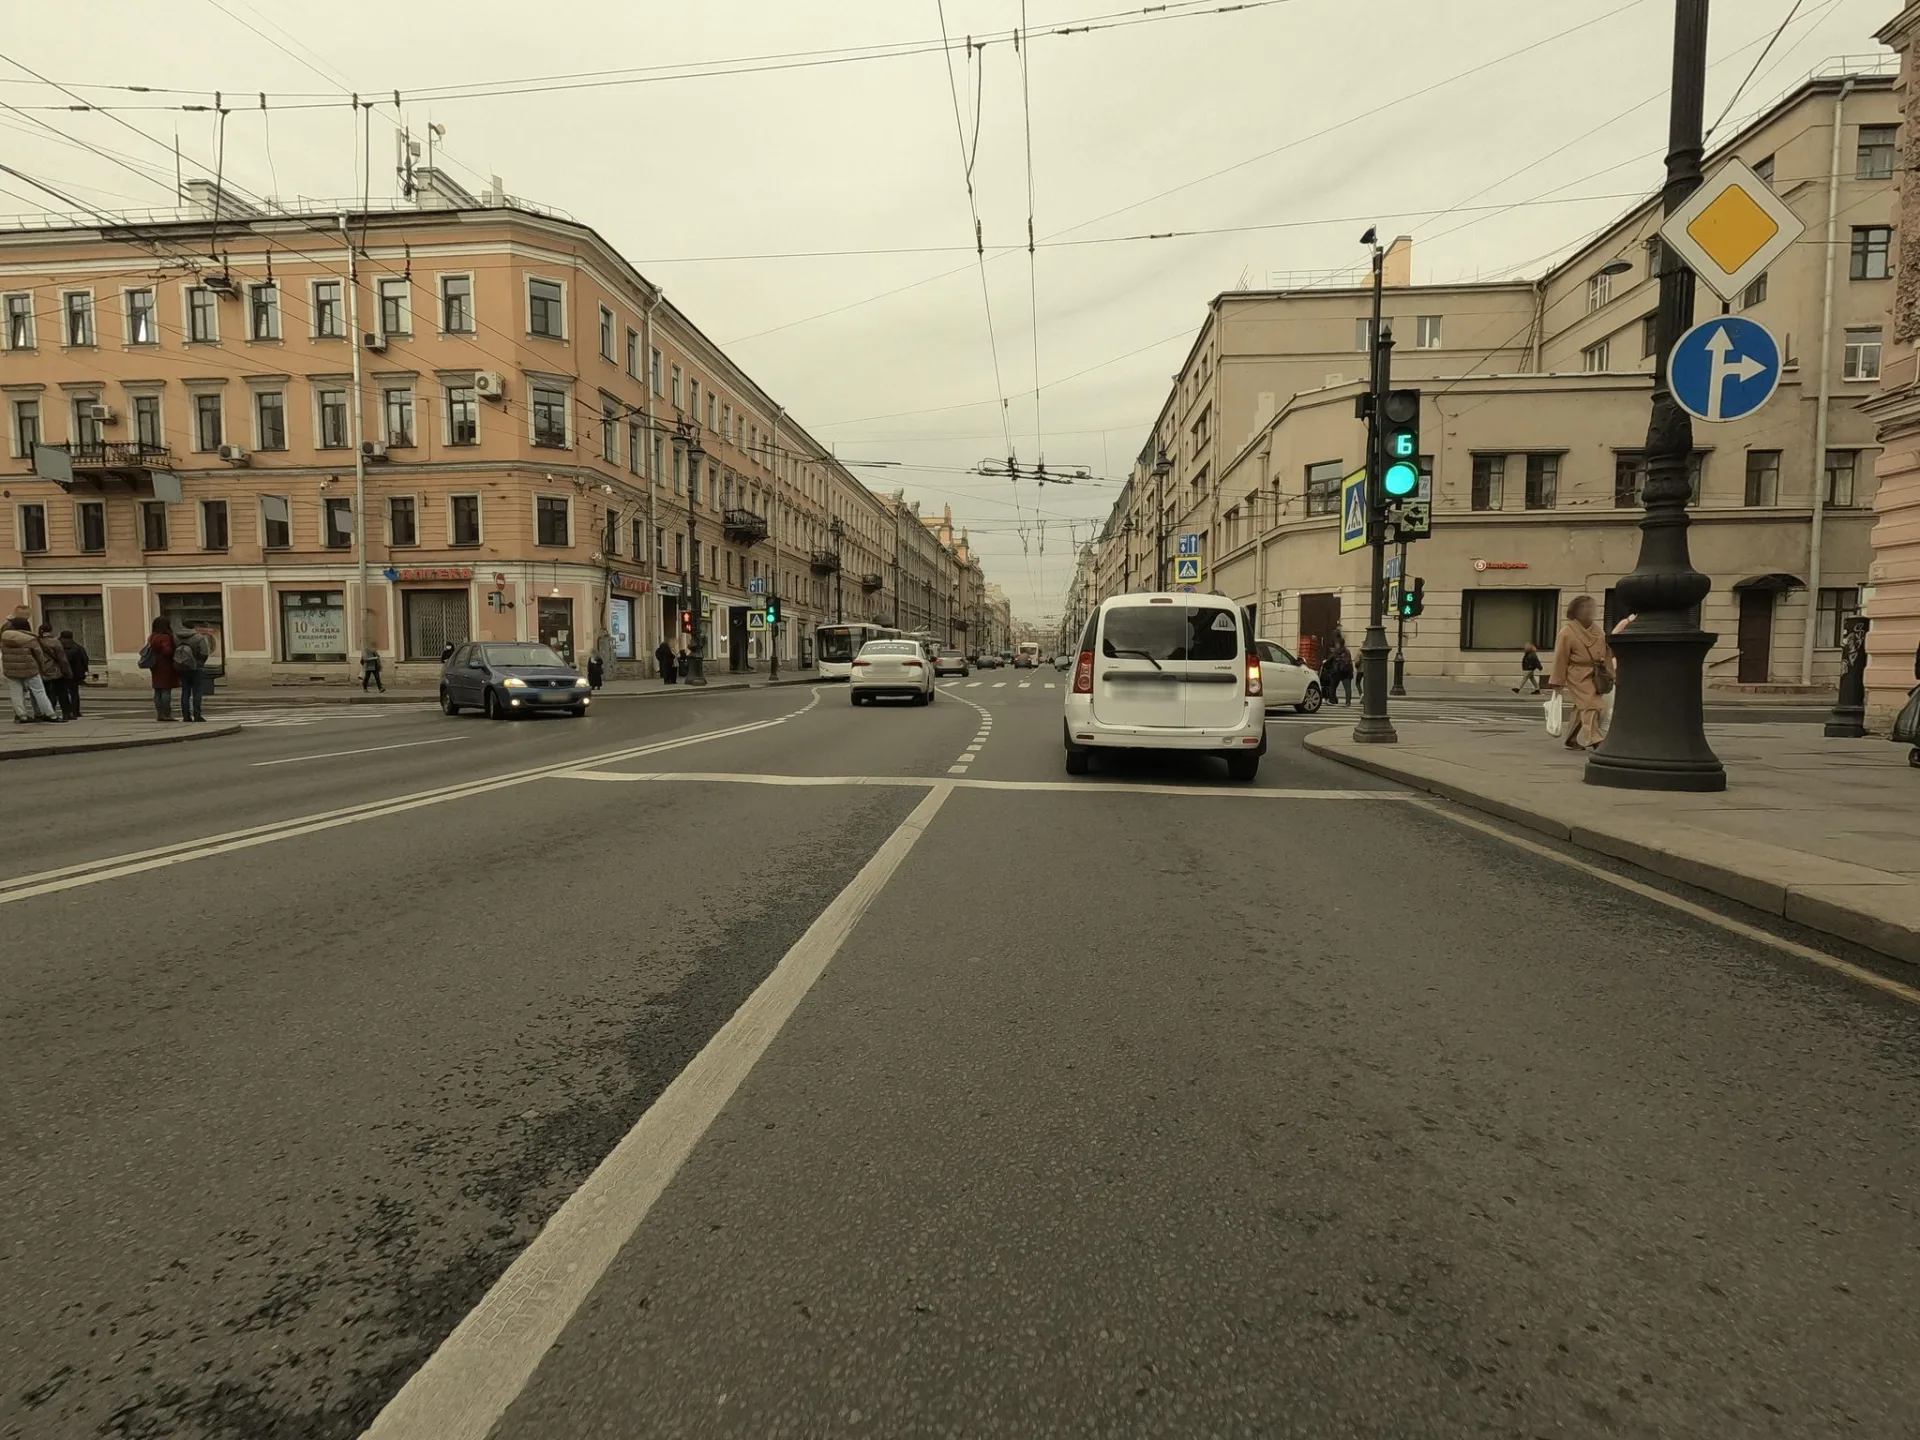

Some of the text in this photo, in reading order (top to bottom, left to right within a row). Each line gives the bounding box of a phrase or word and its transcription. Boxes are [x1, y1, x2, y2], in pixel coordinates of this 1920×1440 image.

[1397, 434, 1412, 455] 6
[400, 568, 473, 580] АПТЕКА
[1407, 593, 1413, 601] 6
